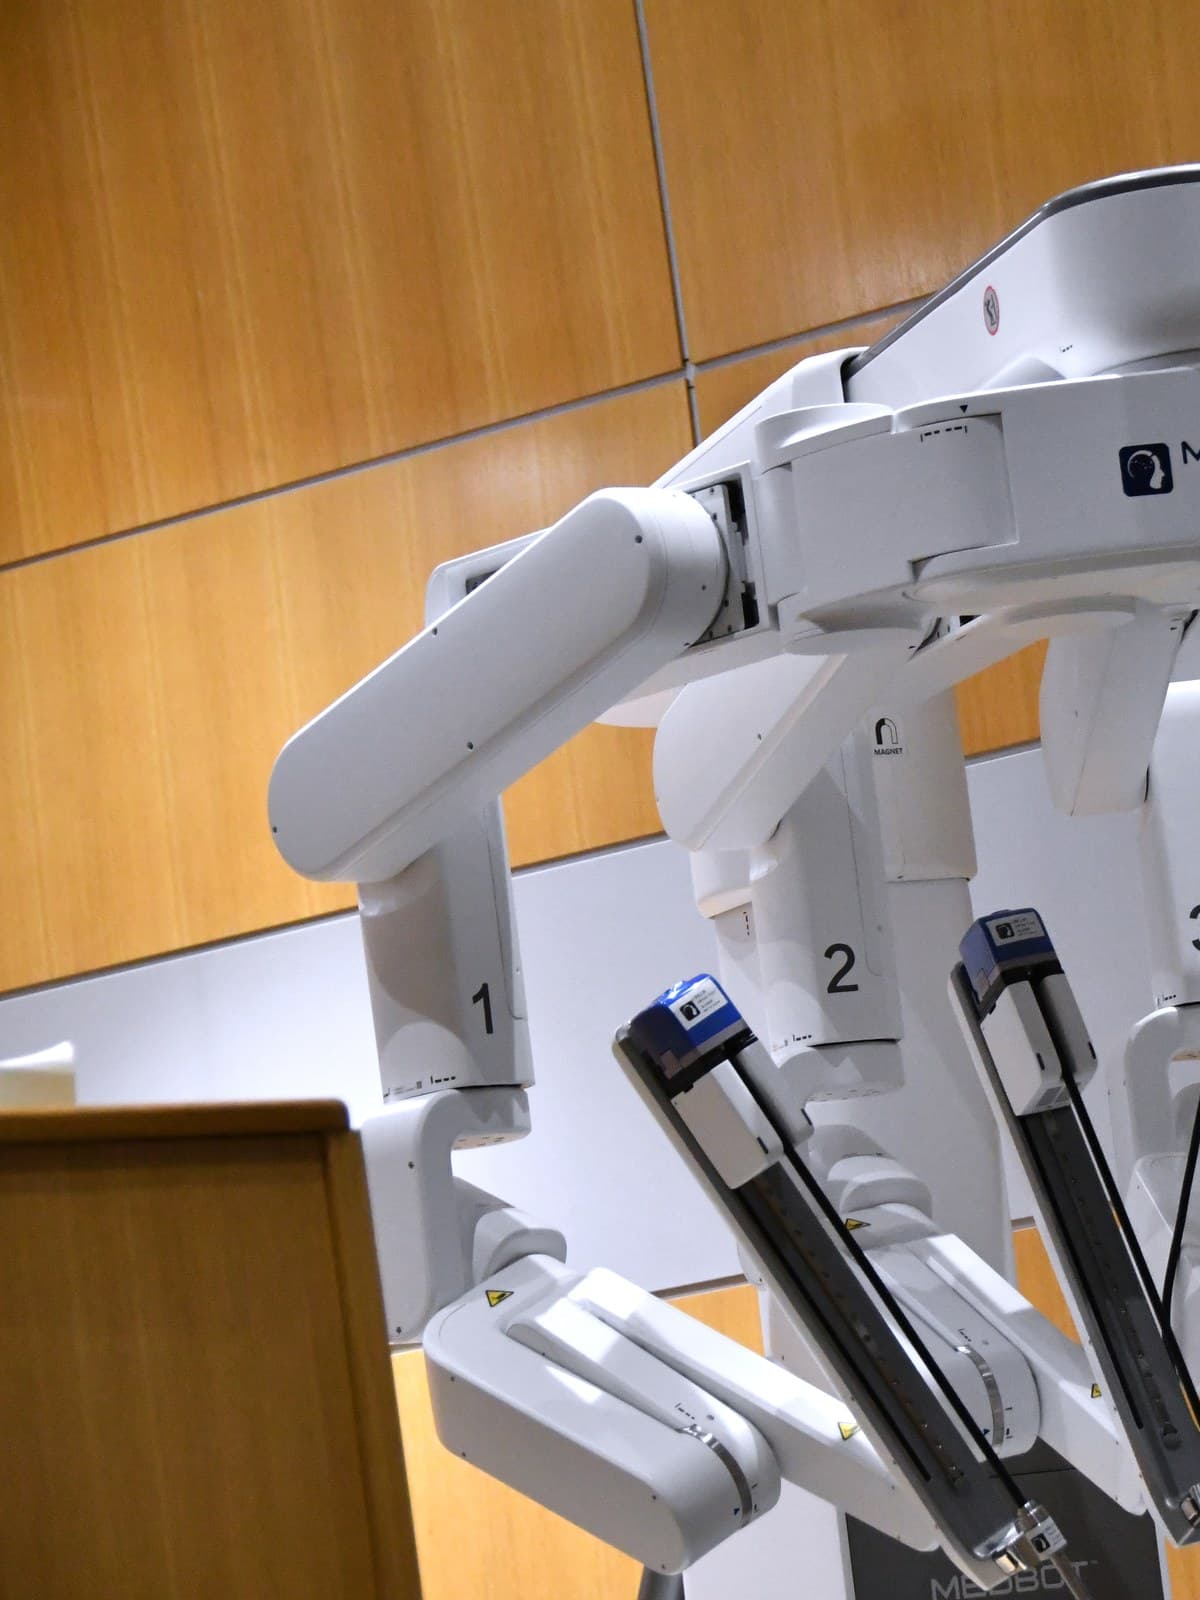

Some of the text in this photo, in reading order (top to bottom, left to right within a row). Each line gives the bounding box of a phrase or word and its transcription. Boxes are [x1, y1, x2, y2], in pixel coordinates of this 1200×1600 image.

[873, 747, 903, 755] MAGNET
[824, 943, 858, 993] 2
[472, 982, 493, 1034] 1
